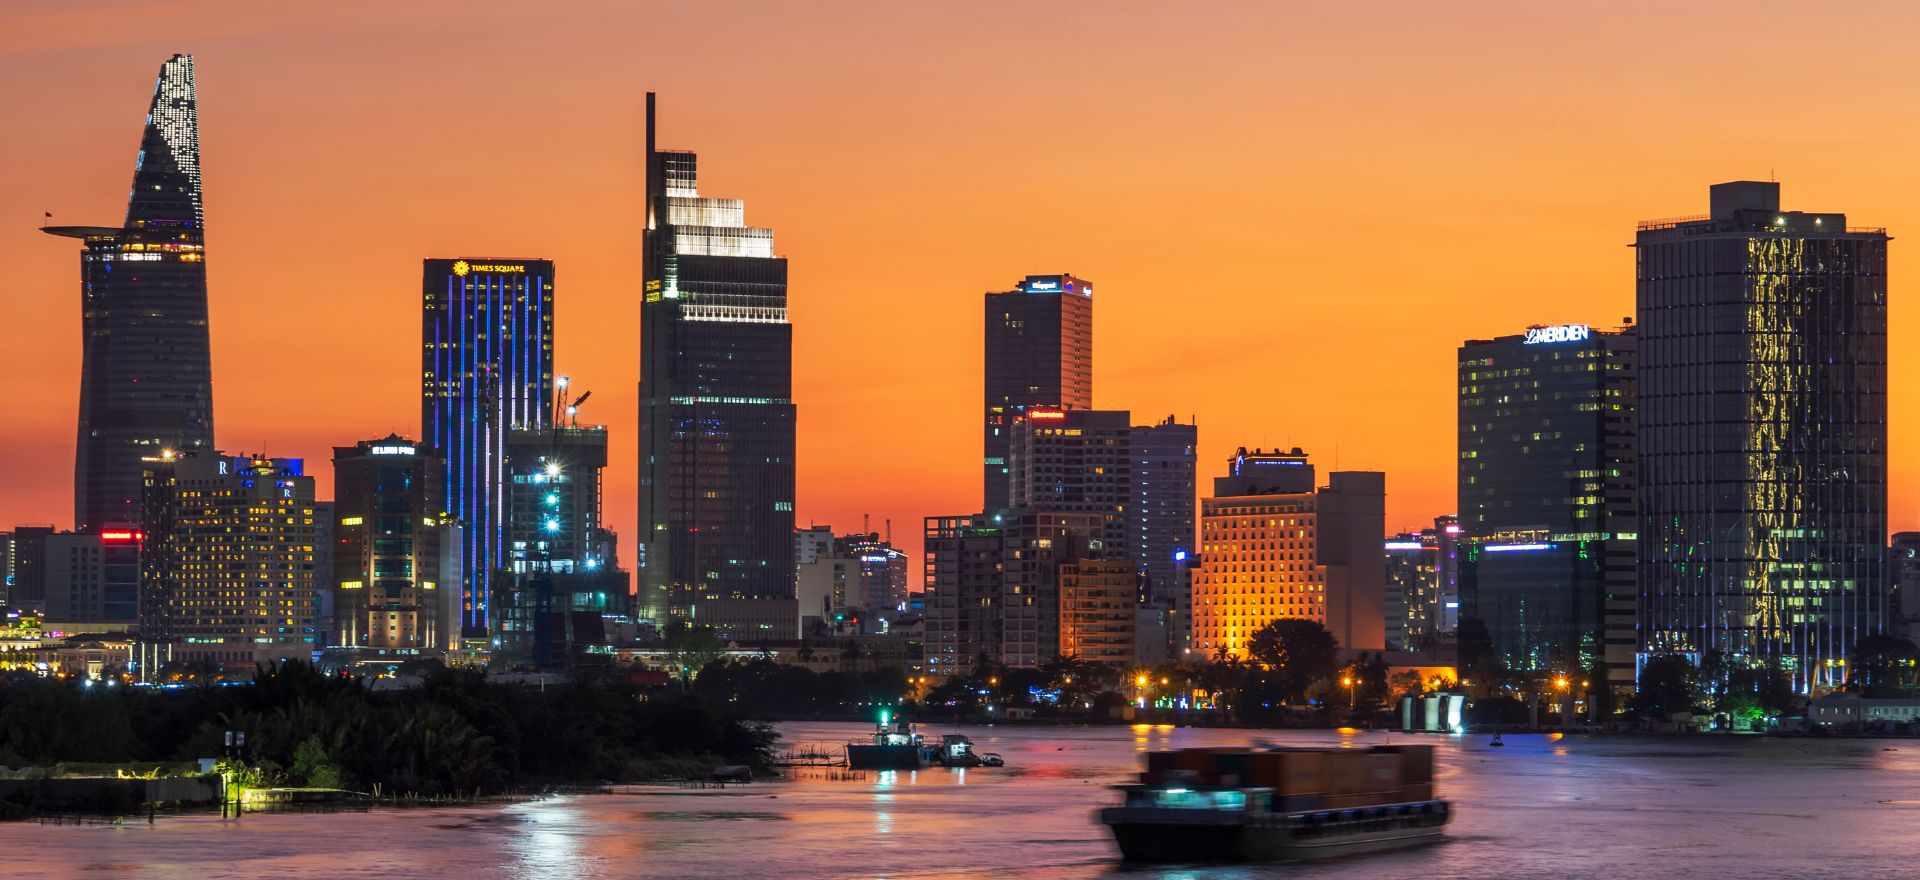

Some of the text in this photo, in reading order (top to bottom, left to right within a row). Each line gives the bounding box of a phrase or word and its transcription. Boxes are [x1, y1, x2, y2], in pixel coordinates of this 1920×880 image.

[471, 264, 525, 273] TIMES SQUARE
[1031, 411, 1064, 419] Sheraton
[219, 461, 228, 475] R
[283, 488, 291, 498] R
